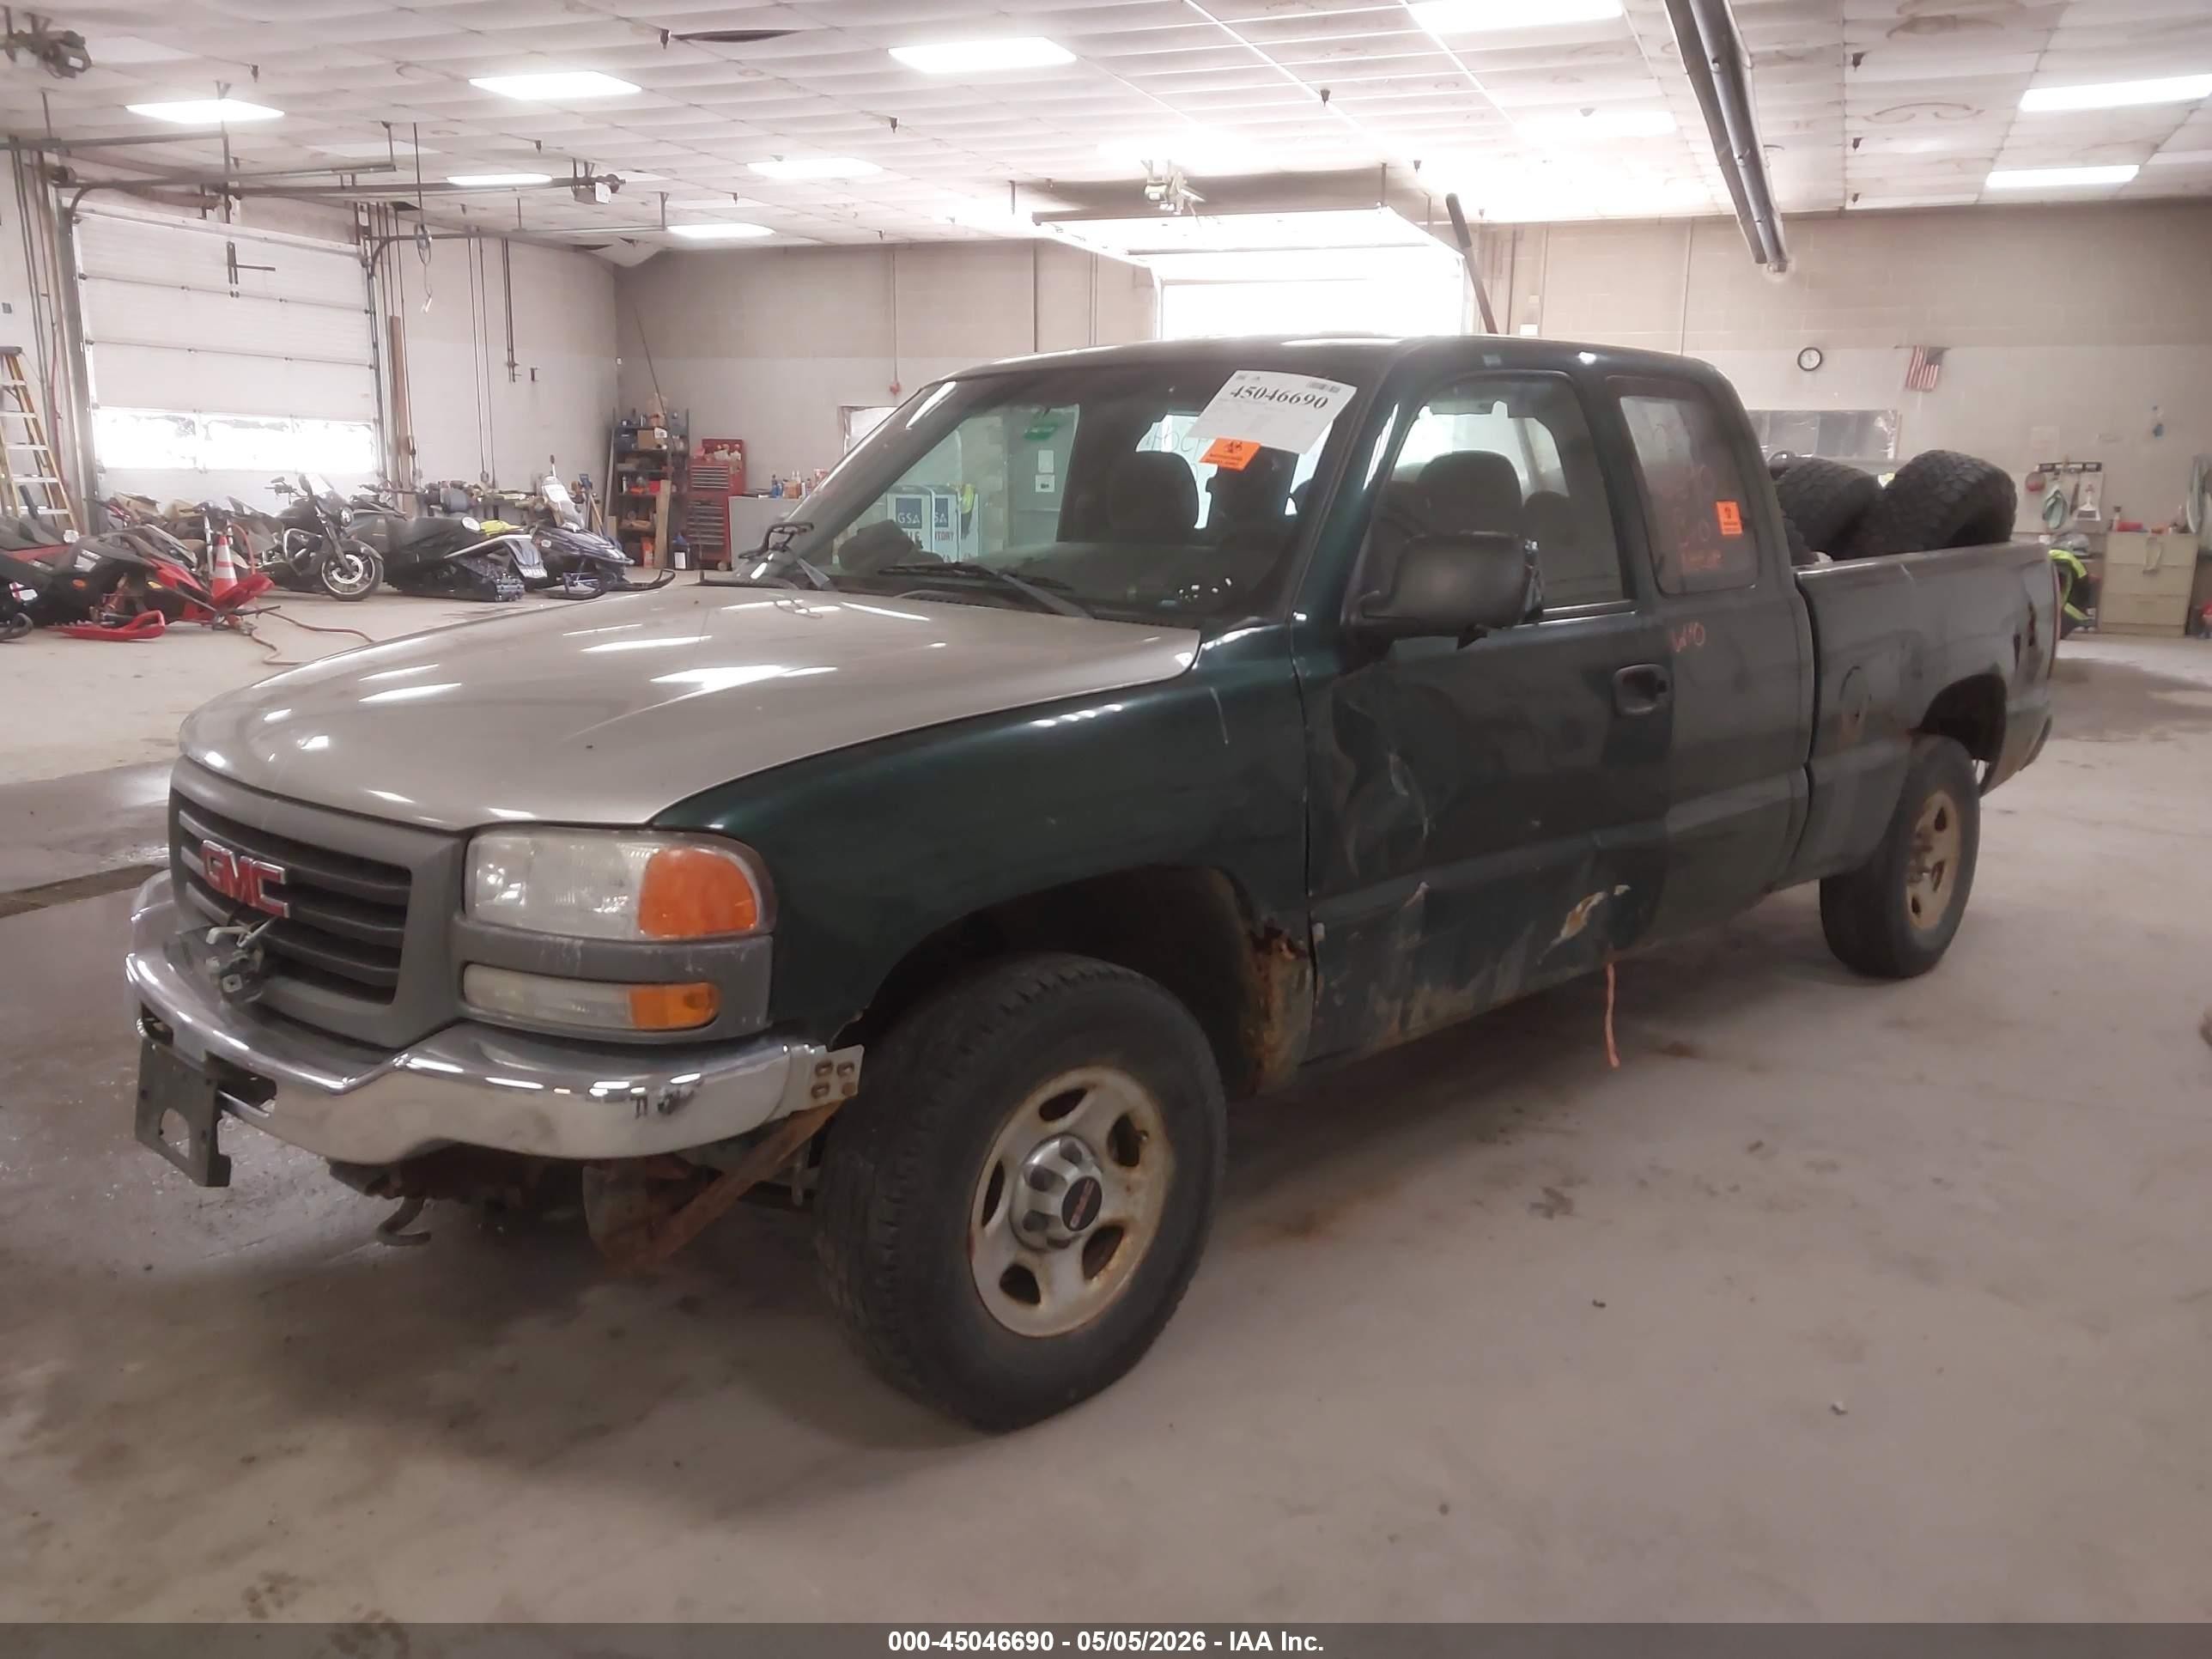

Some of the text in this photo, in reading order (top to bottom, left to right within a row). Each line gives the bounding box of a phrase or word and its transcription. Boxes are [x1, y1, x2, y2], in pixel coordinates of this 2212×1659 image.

[1230, 386, 1328, 410] 45046690
[897, 512, 921, 524] GSA
[934, 512, 947, 524] SA
[200, 838, 291, 919] GMC
